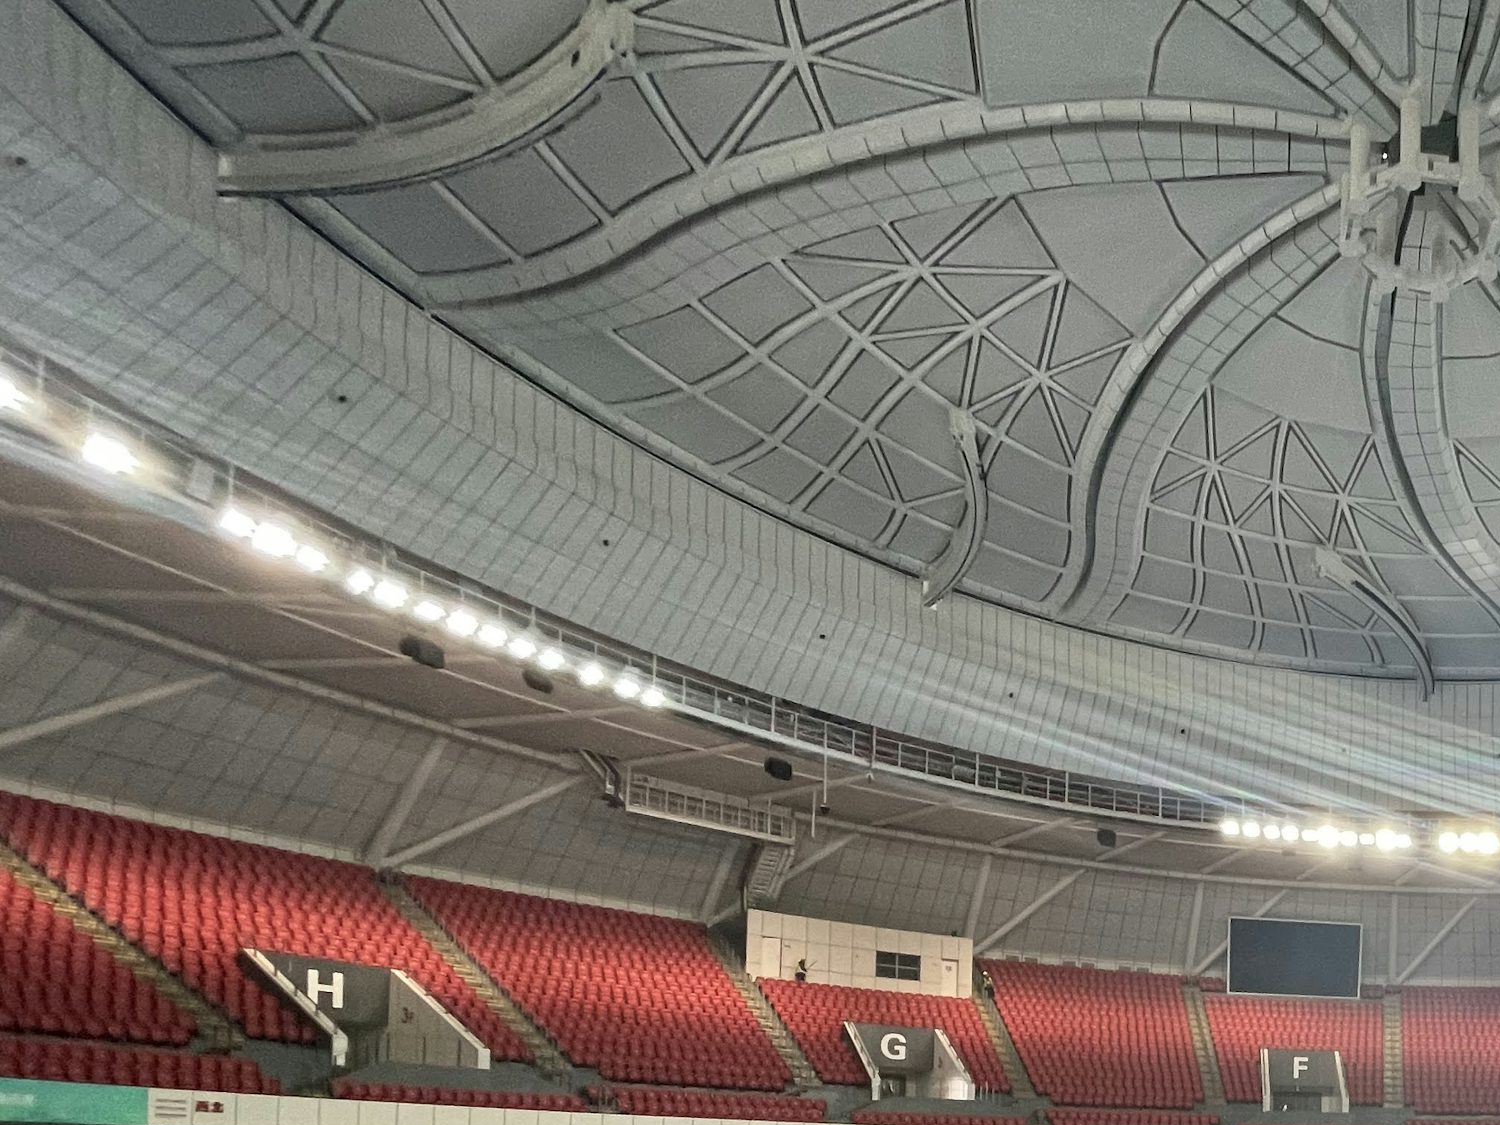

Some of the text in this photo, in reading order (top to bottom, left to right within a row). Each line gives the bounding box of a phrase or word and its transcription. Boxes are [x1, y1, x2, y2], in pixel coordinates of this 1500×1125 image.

[307, 968, 344, 1009] H
[880, 1032, 907, 1060] G
[1293, 1056, 1309, 1079] F
